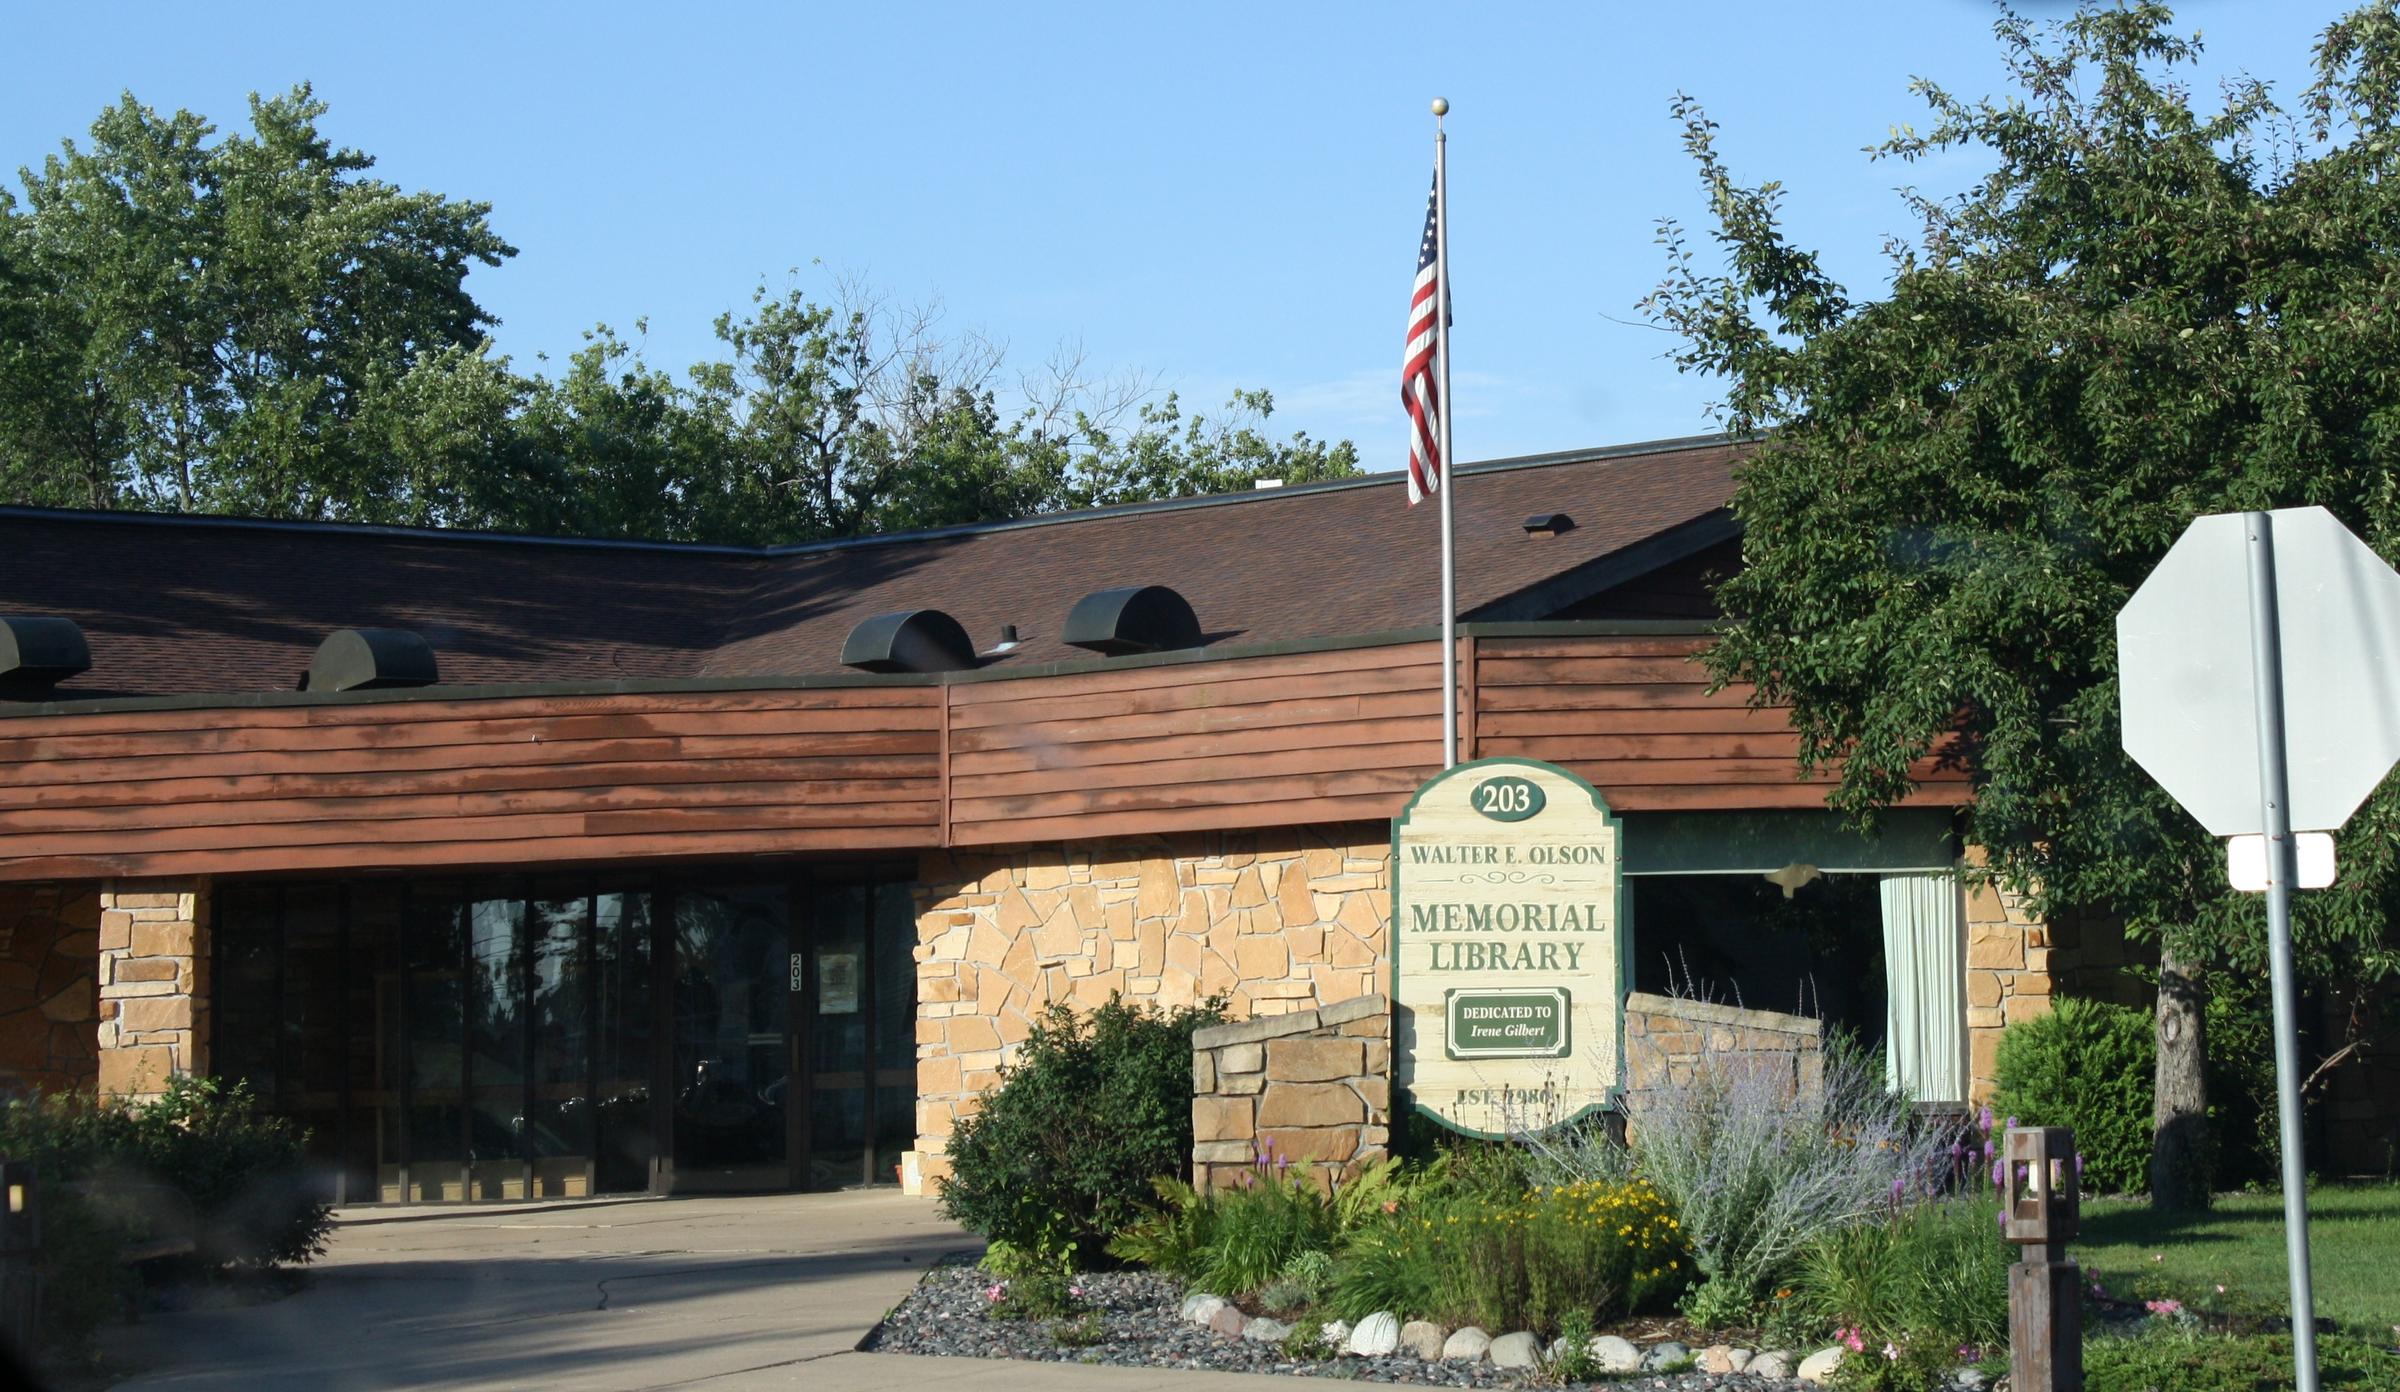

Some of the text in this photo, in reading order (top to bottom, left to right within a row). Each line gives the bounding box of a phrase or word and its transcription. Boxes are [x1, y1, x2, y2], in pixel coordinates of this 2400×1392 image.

[1483, 785, 1530, 812] 203
[1410, 846, 1606, 865] WALTER E. OLSON
[1410, 904, 1606, 933] MEMORIAL
[1429, 942, 1585, 971] LIBRARY
[791, 954, 800, 990] 203
[1463, 1006, 1551, 1019] DEDICATED TO
[1471, 1024, 1545, 1037] Irene Gilbert
